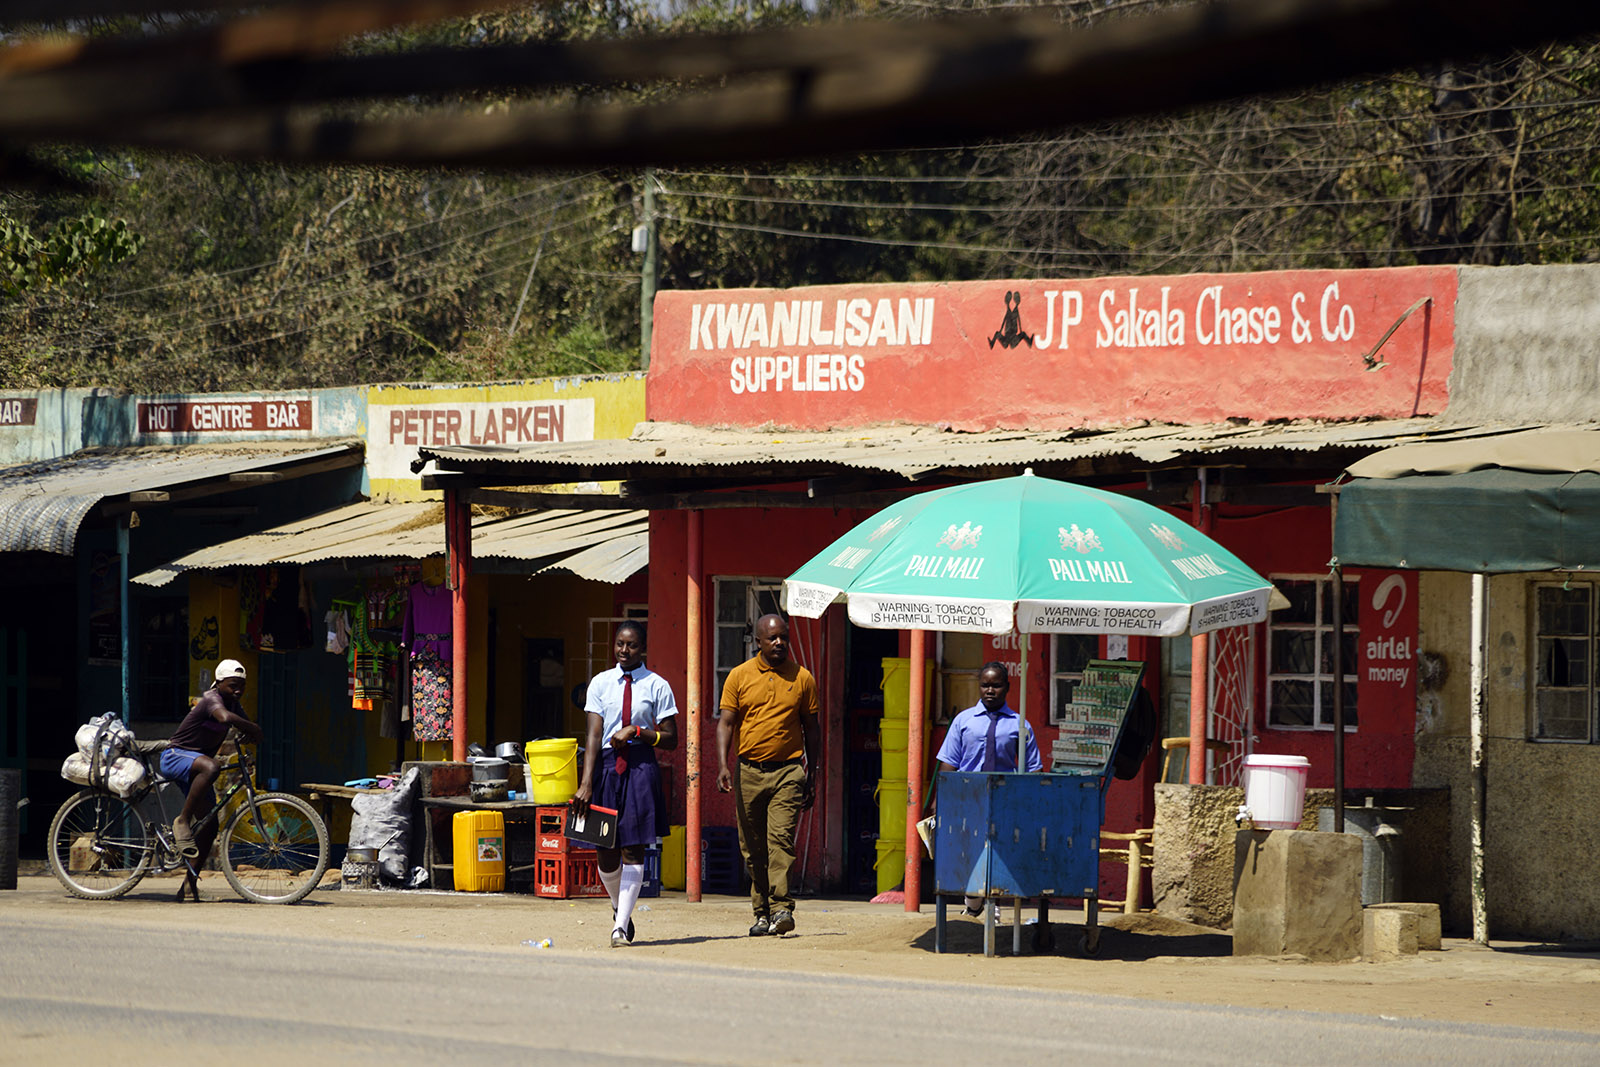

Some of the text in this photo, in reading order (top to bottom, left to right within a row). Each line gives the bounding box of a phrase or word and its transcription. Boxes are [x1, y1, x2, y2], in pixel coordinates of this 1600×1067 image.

[690, 298, 935, 350] KWANILISANI
[1035, 281, 1355, 350] JP Sakala Chase & Co
[730, 354, 865, 394] SUPPLIERS
[149, 403, 300, 430] HOT CENTRE BAR
[390, 405, 564, 445] PETER LAPKEN
[904, 555, 984, 579] PALL MALL
[1048, 558, 1133, 583] PALL MALL
[1171, 553, 1228, 580] PALL MALL
[878, 602, 985, 616] WARNING: TOBACCO
[1044, 606, 1156, 618] WARNING: TOBACCO
[1230, 596, 1256, 611] TOBACCO
[871, 613, 993, 627] IS HARMFUL TO HEALTH
[1034, 616, 1162, 629] IS HARMFUL TO HEALTH
[1205, 613, 1229, 626] HARMFUL
[1238, 606, 1260, 618] HEALTH
[1368, 667, 1409, 688] money
